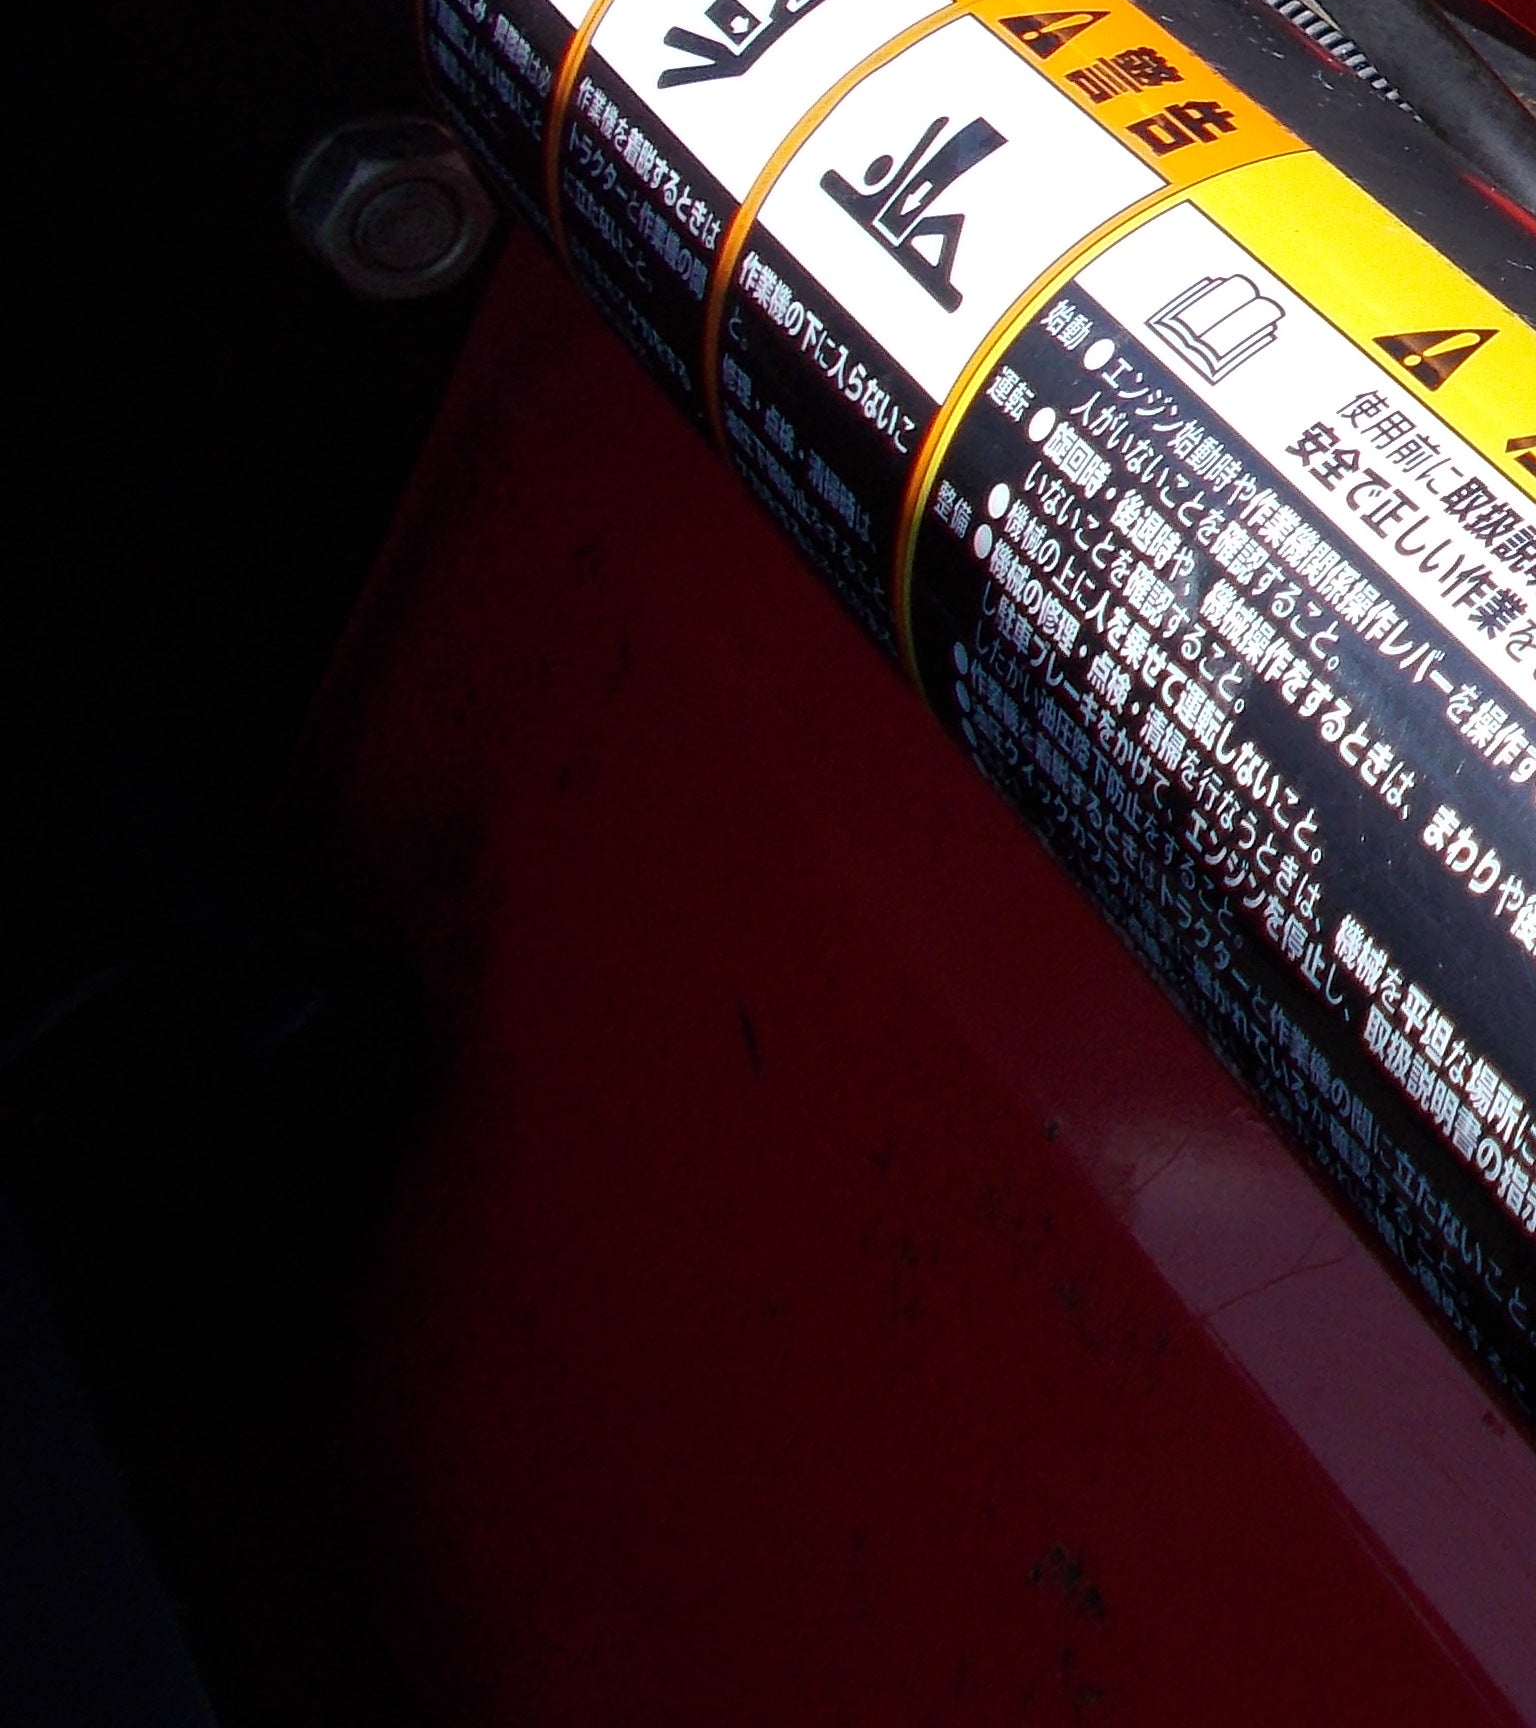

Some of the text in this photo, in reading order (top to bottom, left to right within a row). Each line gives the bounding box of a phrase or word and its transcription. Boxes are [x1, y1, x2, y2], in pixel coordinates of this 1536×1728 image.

[1064, 45, 1238, 158] 警告
[738, 250, 919, 455] 作業機の下に入らないこ
[985, 364, 1035, 423] 運転
[1040, 298, 1094, 351] 始動
[1024, 460, 1246, 714] いないことを確認すること。
[1069, 390, 1340, 671] 人がいないことを確認すること。
